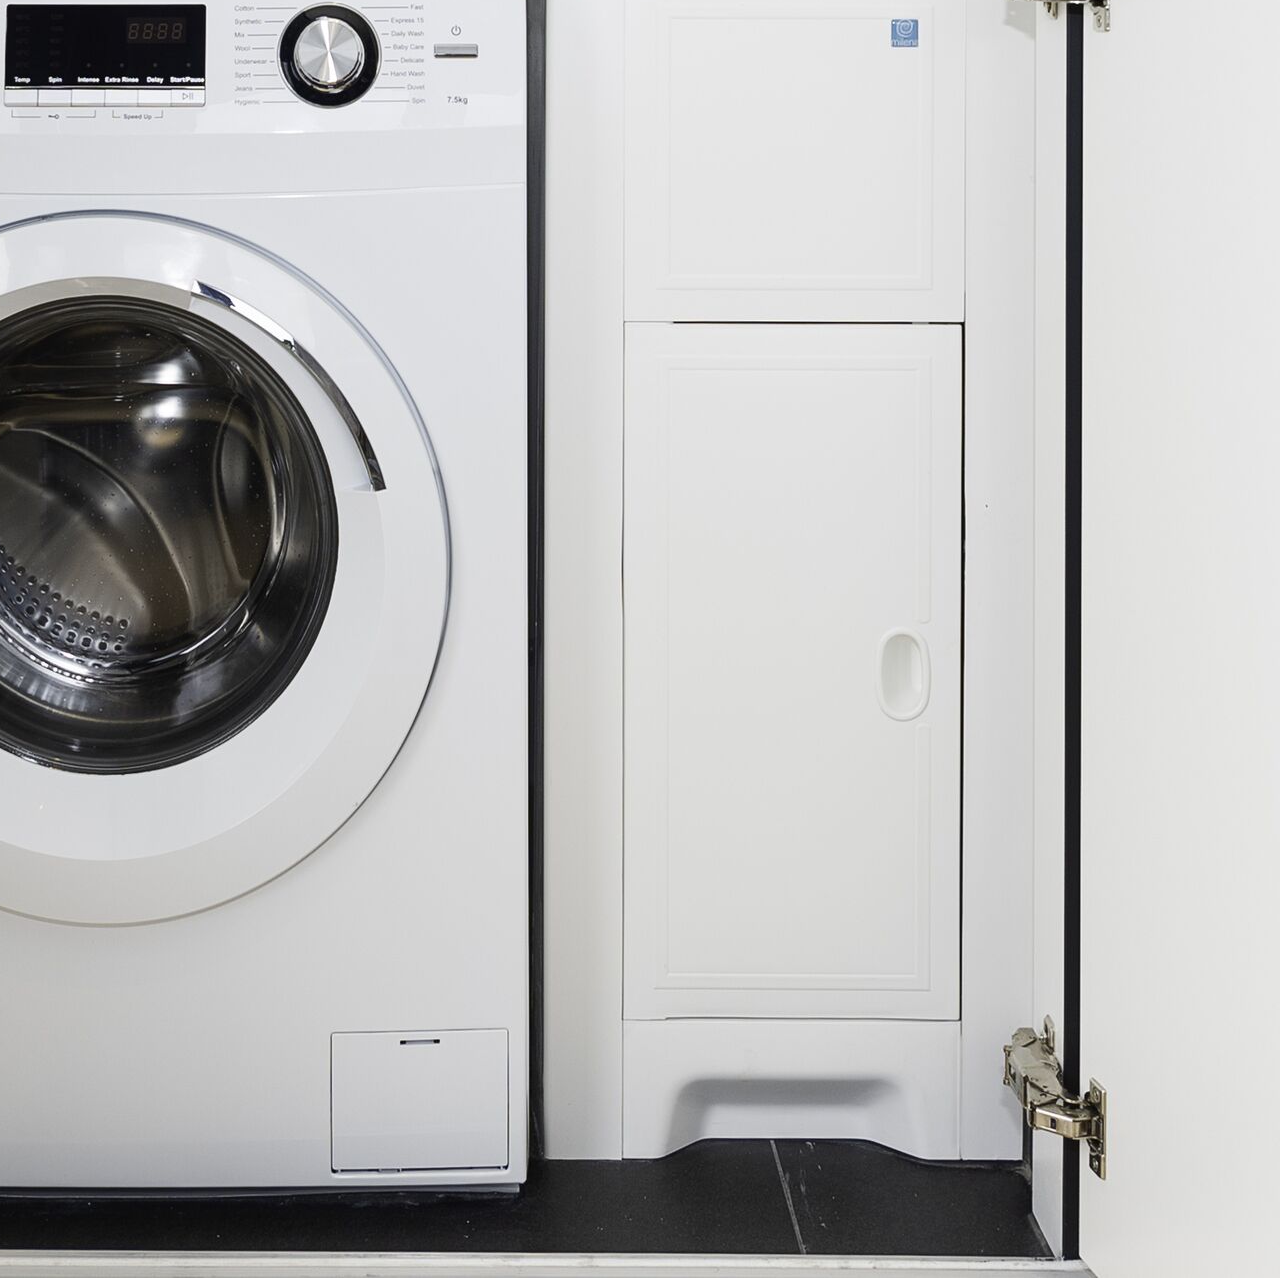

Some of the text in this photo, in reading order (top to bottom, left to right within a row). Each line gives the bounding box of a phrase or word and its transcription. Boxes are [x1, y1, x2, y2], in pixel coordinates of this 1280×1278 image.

[234, 18, 262, 26] Synthetic
[391, 30, 406, 38] Daily
[14, 76, 31, 84] Temp
[48, 76, 63, 84] Spin
[146, 76, 164, 84] Delay
[411, 97, 426, 105] Spin
[447, 96, 468, 105] 7.5kg
